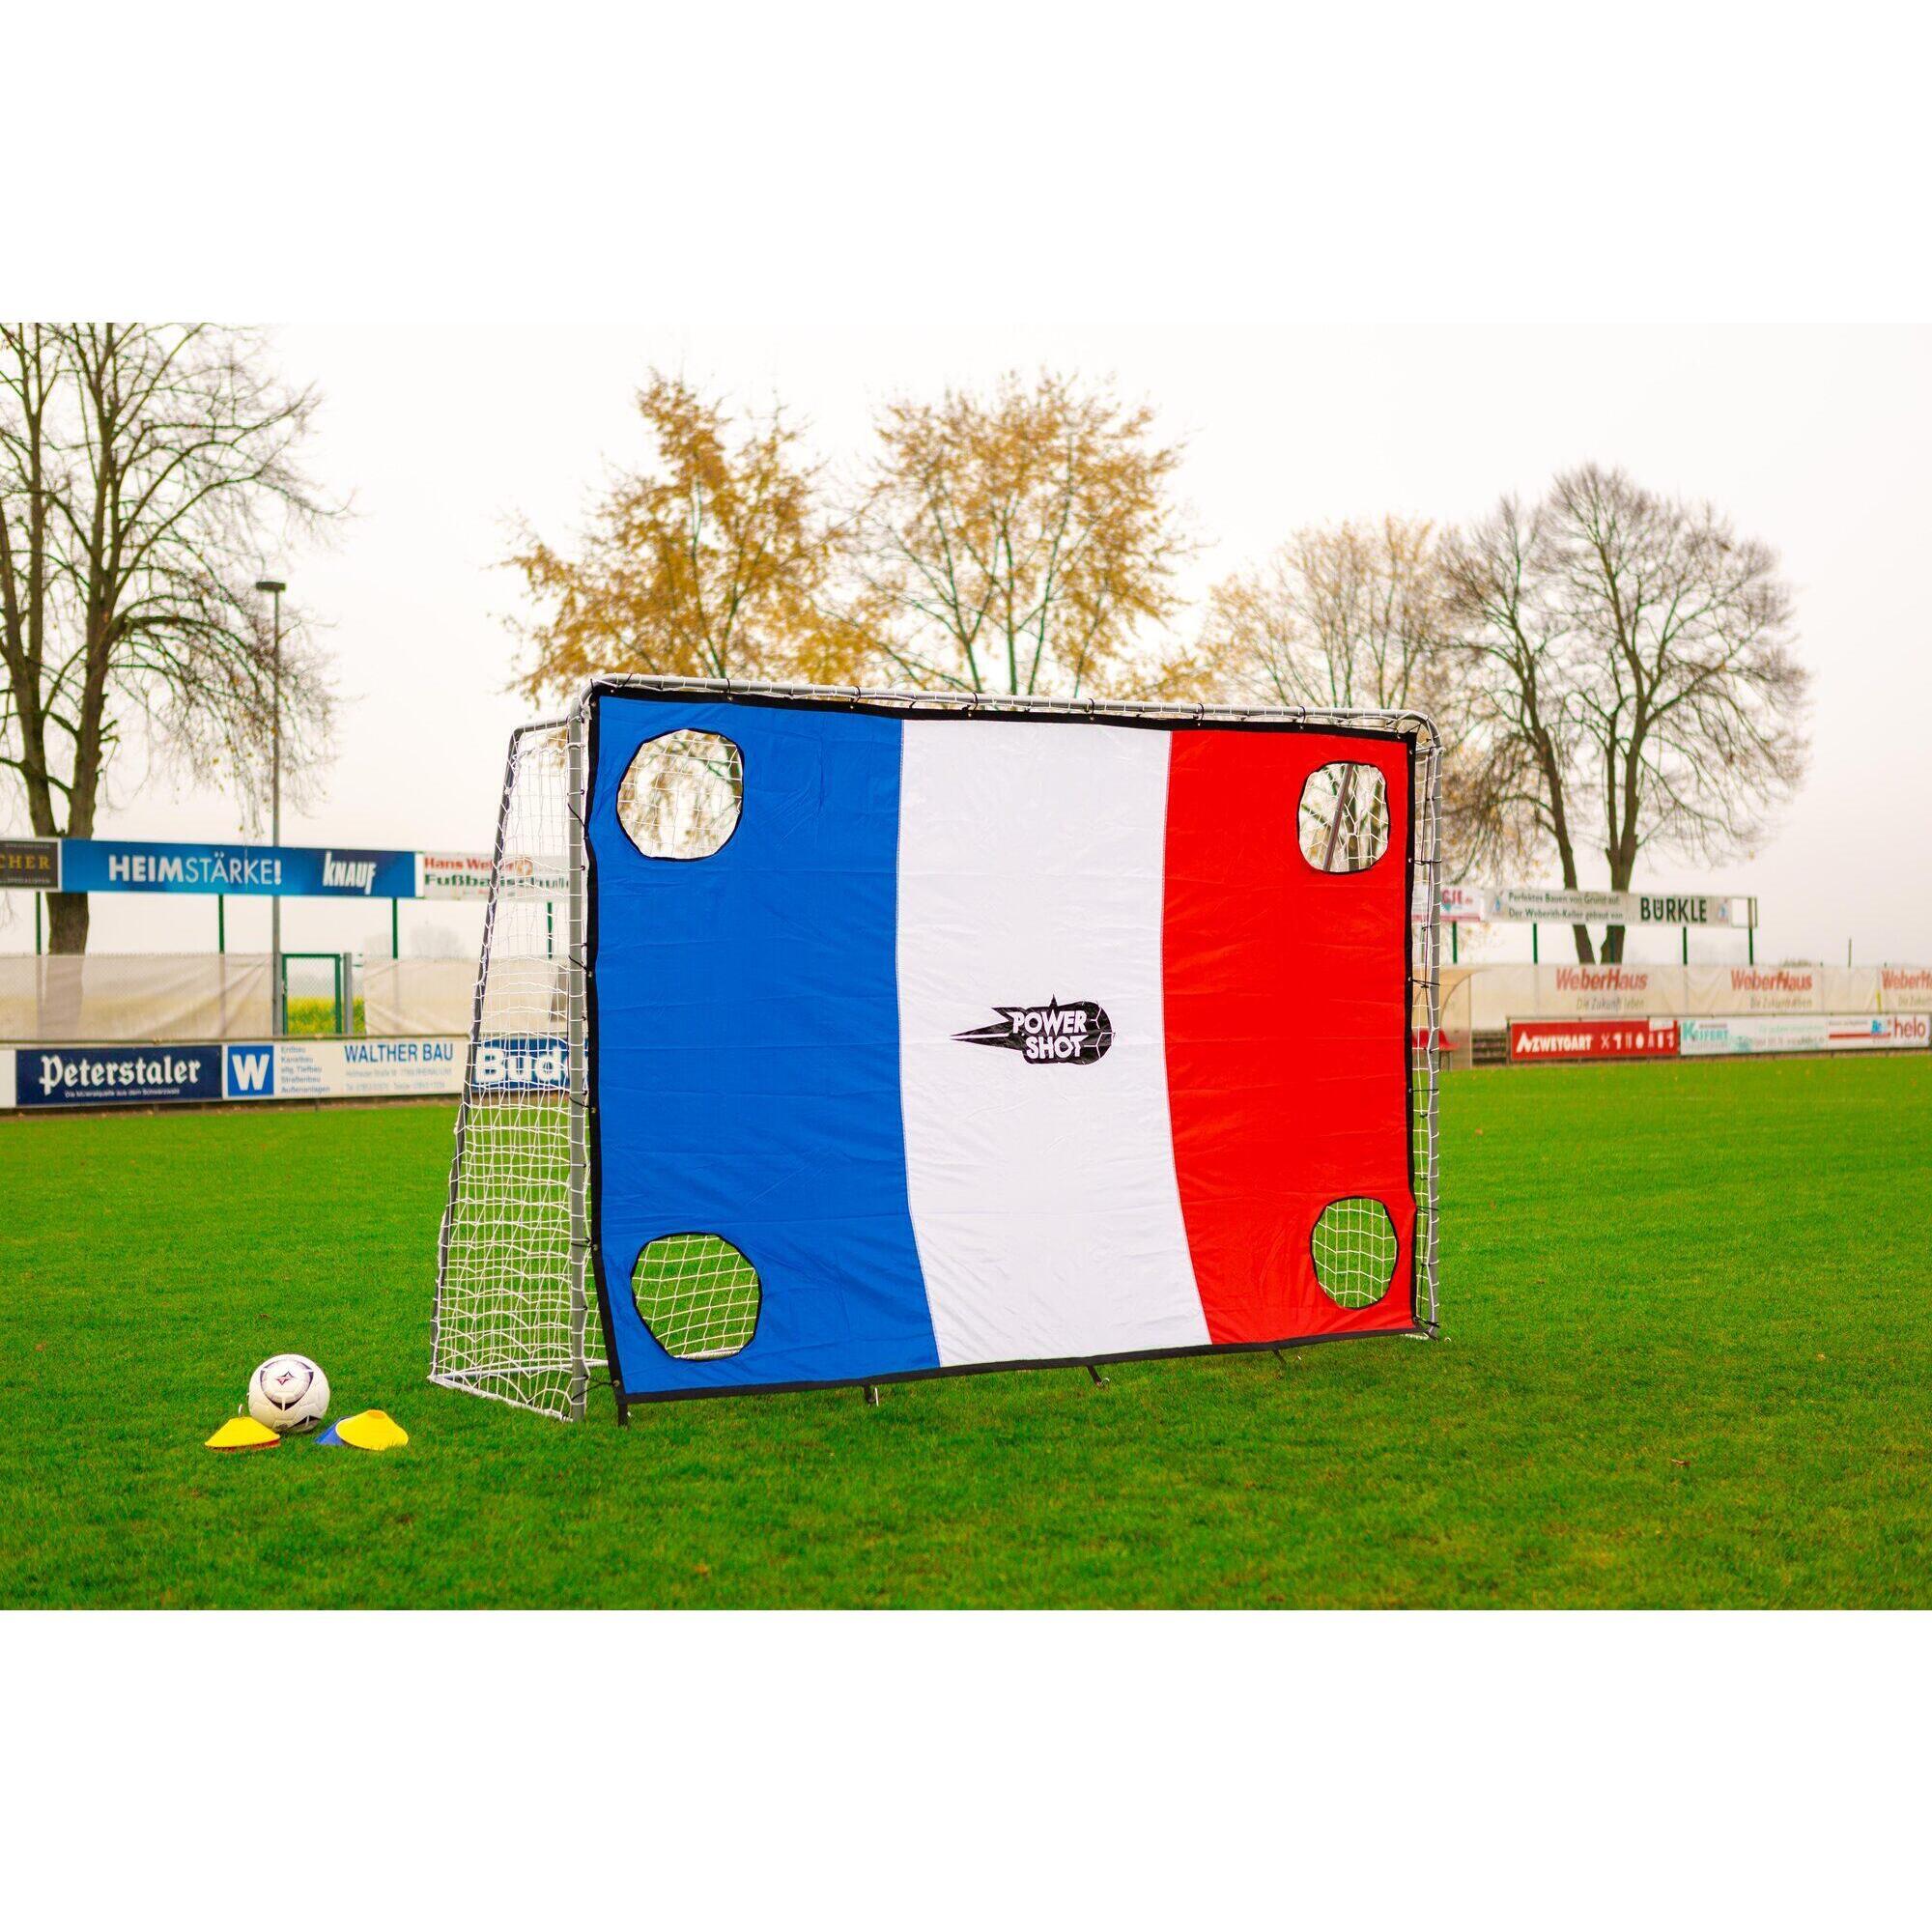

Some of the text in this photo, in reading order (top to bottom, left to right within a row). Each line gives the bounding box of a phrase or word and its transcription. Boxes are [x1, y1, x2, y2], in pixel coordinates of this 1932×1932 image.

[108, 851, 282, 885] HEIMSTÄRKE!
[424, 857, 464, 870] Hans
[1640, 896, 1707, 923] BÜRKLE
[1556, 968, 1648, 990] WeberHaus
[1731, 969, 1813, 990] WeberHaus
[1881, 970, 1932, 990] WeberH
[1007, 1009, 1088, 1036] POWER
[1893, 1016, 1927, 1038] helo
[344, 1043, 454, 1063] WALTHER BAU
[1025, 1035, 1089, 1060] SHOT
[39, 1054, 201, 1095] Peterstaler
[232, 1053, 270, 1091] W
[475, 1046, 570, 1083] Bud
